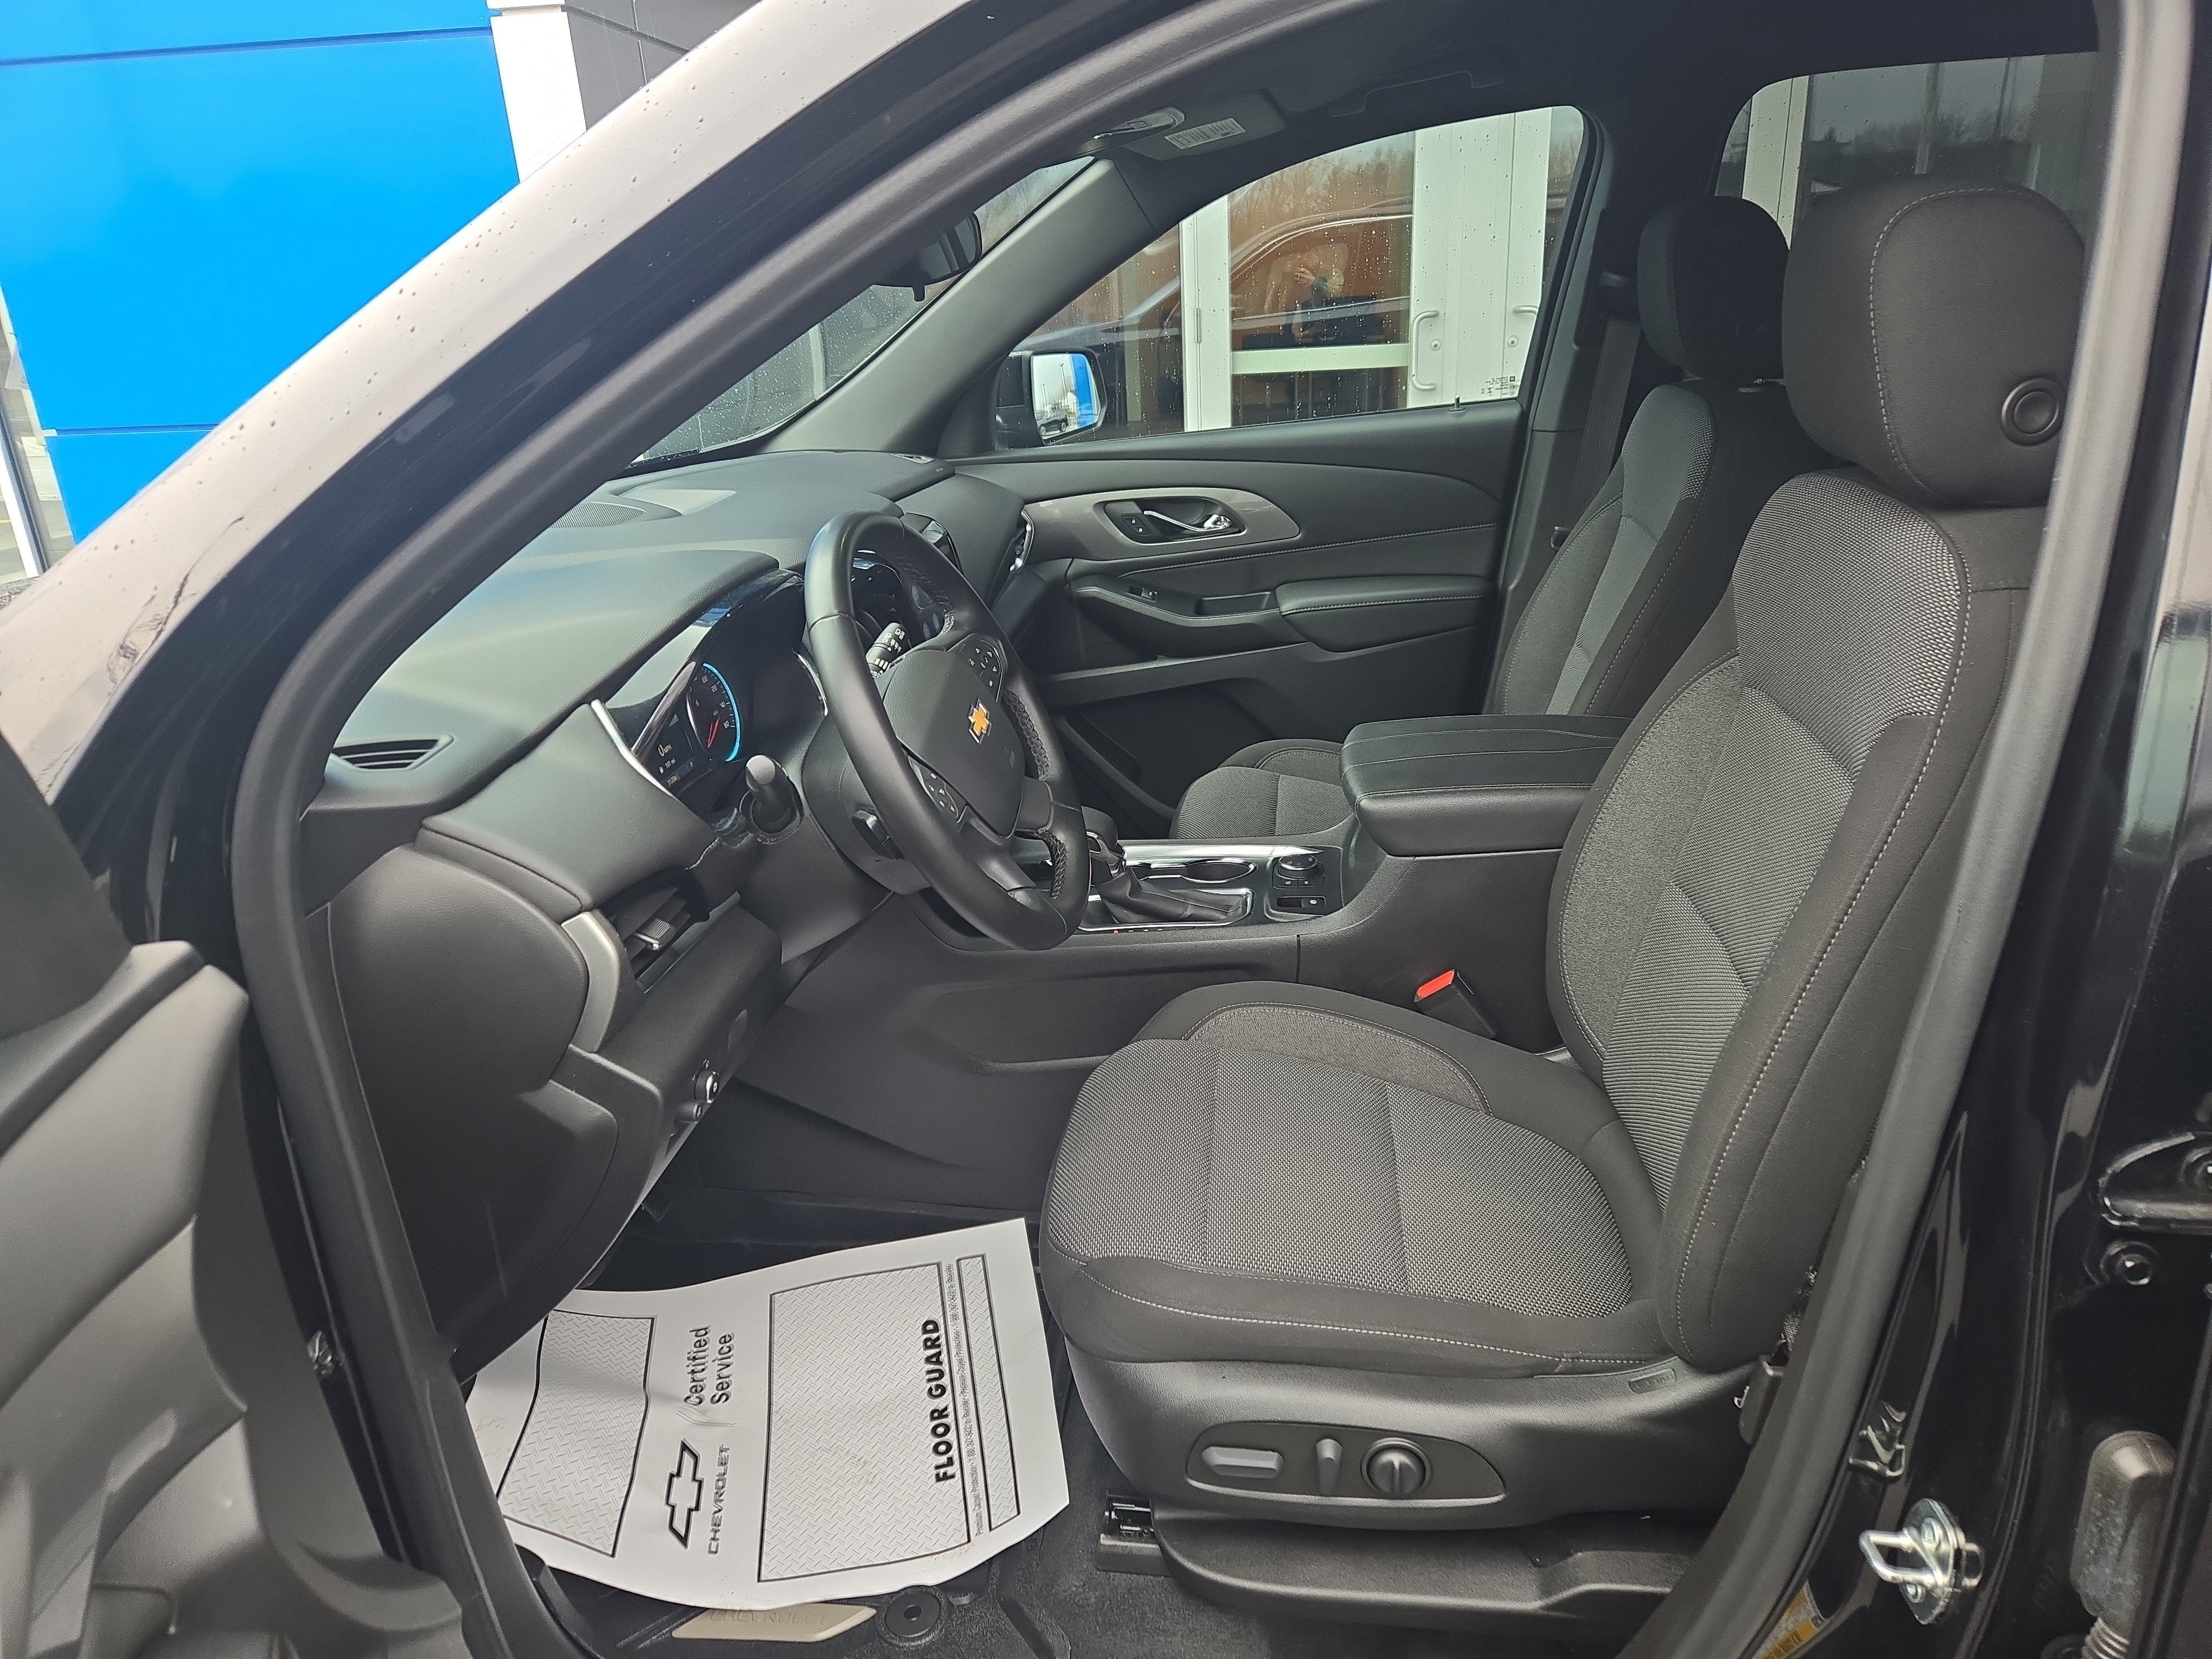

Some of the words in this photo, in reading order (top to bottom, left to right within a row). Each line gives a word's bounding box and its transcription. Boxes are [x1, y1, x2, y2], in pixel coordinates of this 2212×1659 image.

[684, 1325, 711, 1406] Certified
[710, 1332, 735, 1405] Service
[922, 1318, 947, 1399] GUARD
[929, 1405, 956, 1483] FLOOR
[708, 1444, 730, 1555] CHEVROLET
